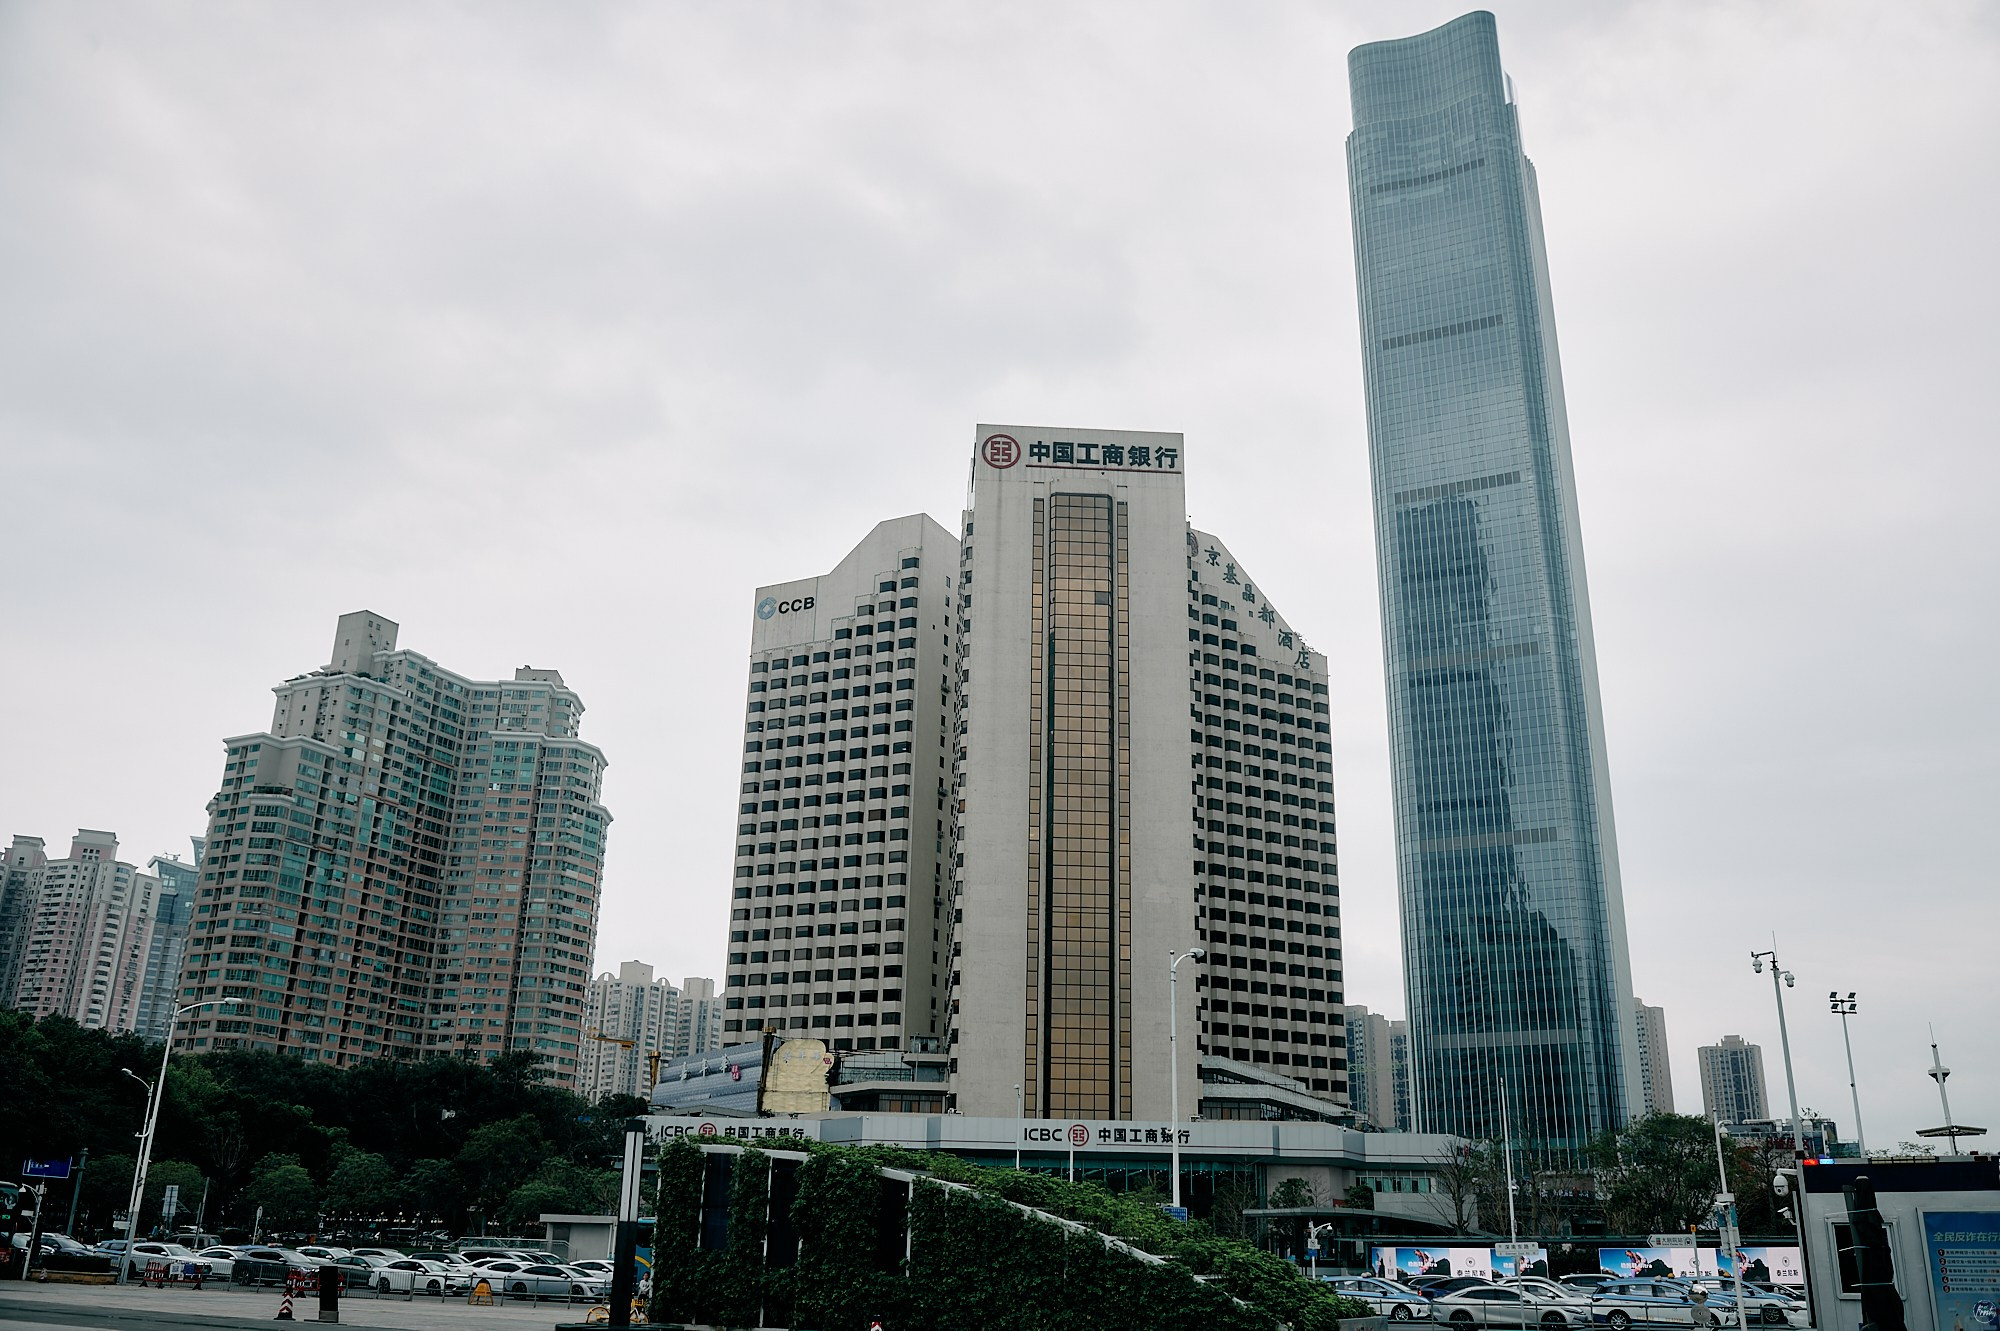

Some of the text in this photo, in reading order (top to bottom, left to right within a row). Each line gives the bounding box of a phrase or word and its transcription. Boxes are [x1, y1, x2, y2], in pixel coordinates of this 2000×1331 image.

[1029, 441, 1178, 469] 中国工商银行
[778, 597, 815, 614] CCB
[1204, 545, 1310, 669] 京基晶都酒店
[660, 1125, 695, 1138] ICBC
[724, 1125, 805, 1140] 中国工商银行
[1024, 1128, 1062, 1141] ICBC
[1098, 1127, 1191, 1144] 中国工商银行
[1933, 1231, 2000, 1242] 全民反诈在行
